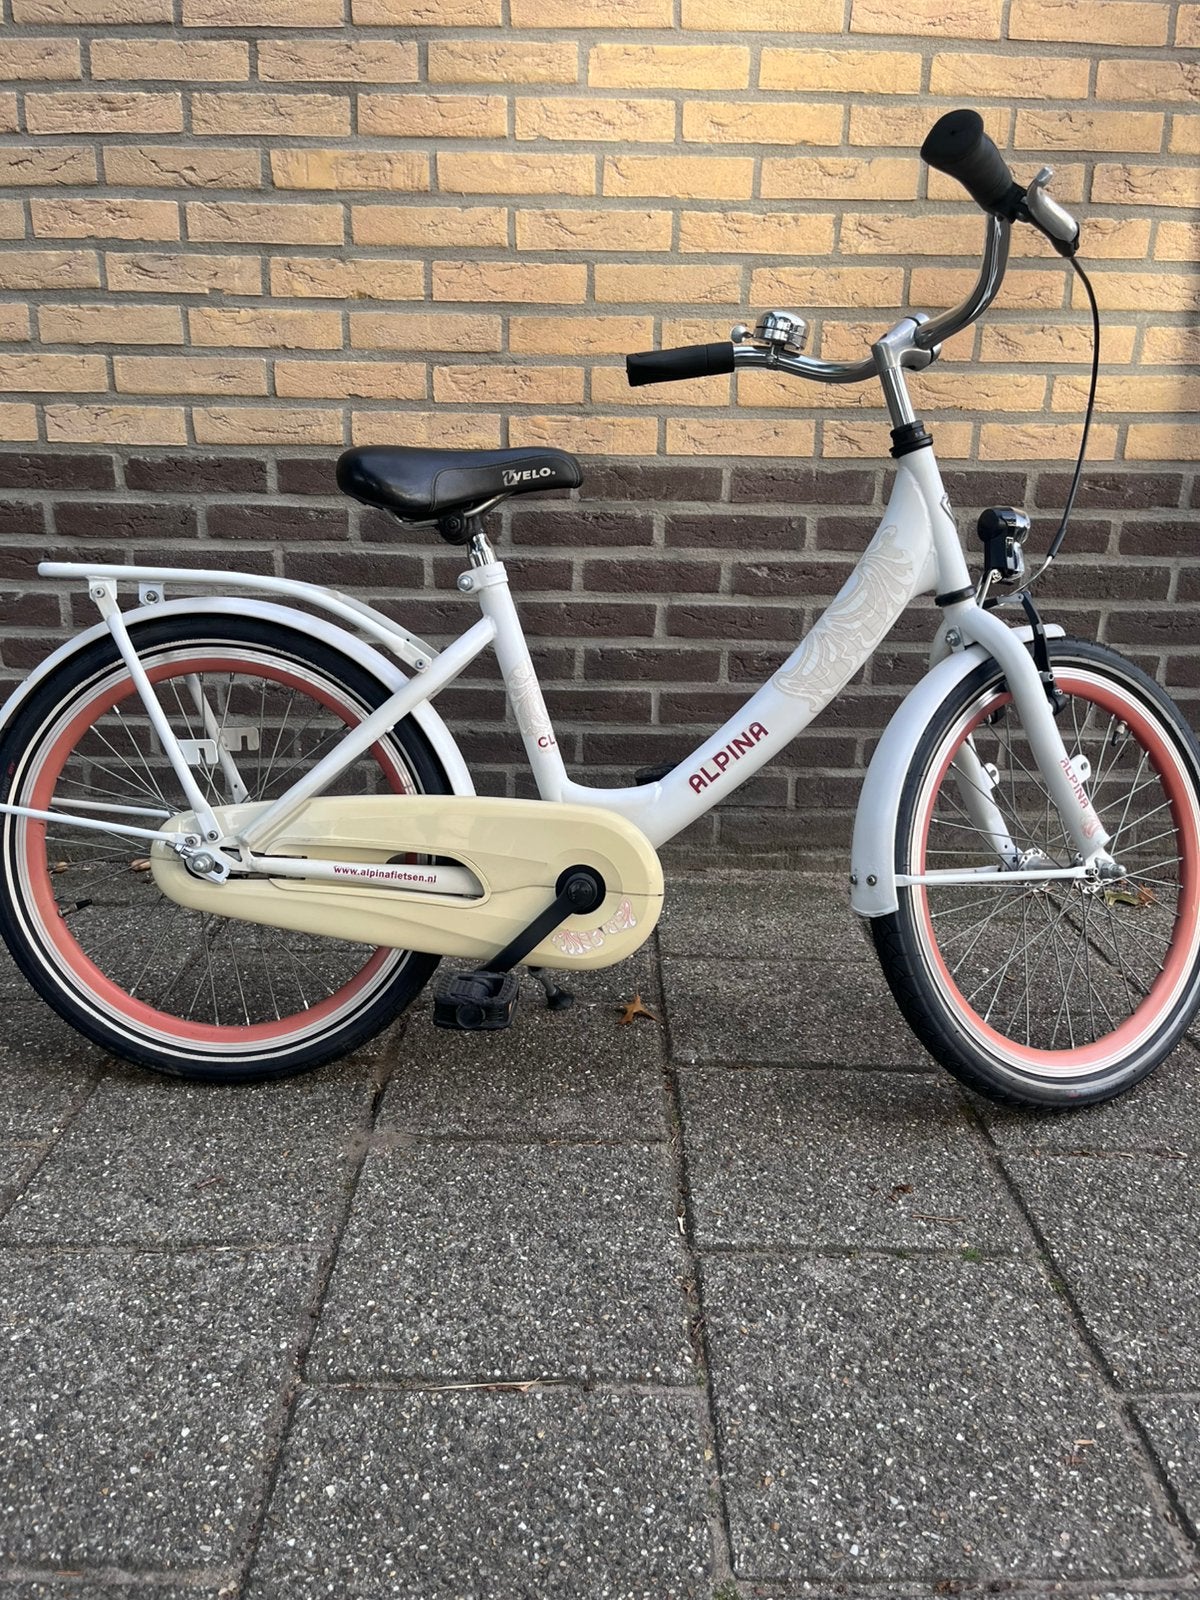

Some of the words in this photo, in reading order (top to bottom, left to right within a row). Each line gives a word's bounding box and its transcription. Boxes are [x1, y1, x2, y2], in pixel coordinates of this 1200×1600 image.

[688, 721, 769, 794] ALPINA
[1060, 757, 1089, 809] ALPINA
[333, 865, 437, 883] www.alpinafietsen.nl
